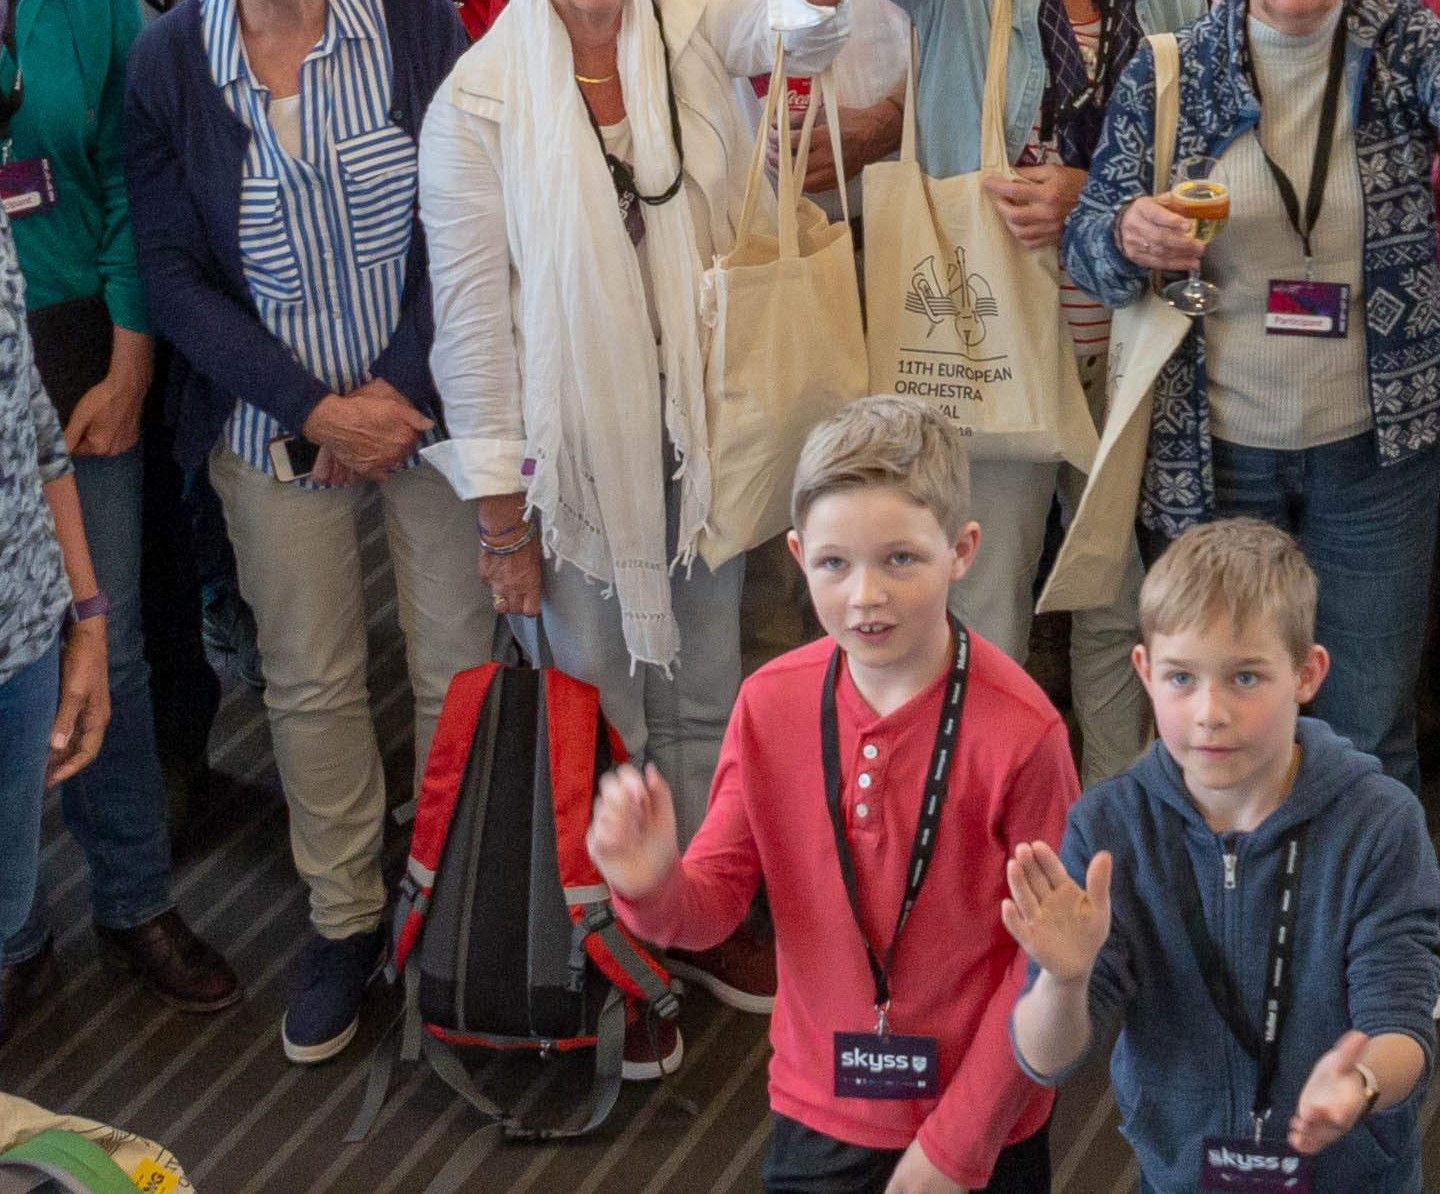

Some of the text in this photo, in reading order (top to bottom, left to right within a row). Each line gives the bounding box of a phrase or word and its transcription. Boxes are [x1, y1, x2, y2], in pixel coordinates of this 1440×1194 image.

[897, 359, 1014, 384] 11TH EUROPEAN
[893, 380, 984, 403] ORCHESTRA
[841, 1047, 909, 1073] skyss
[1207, 1146, 1281, 1172] skyss
